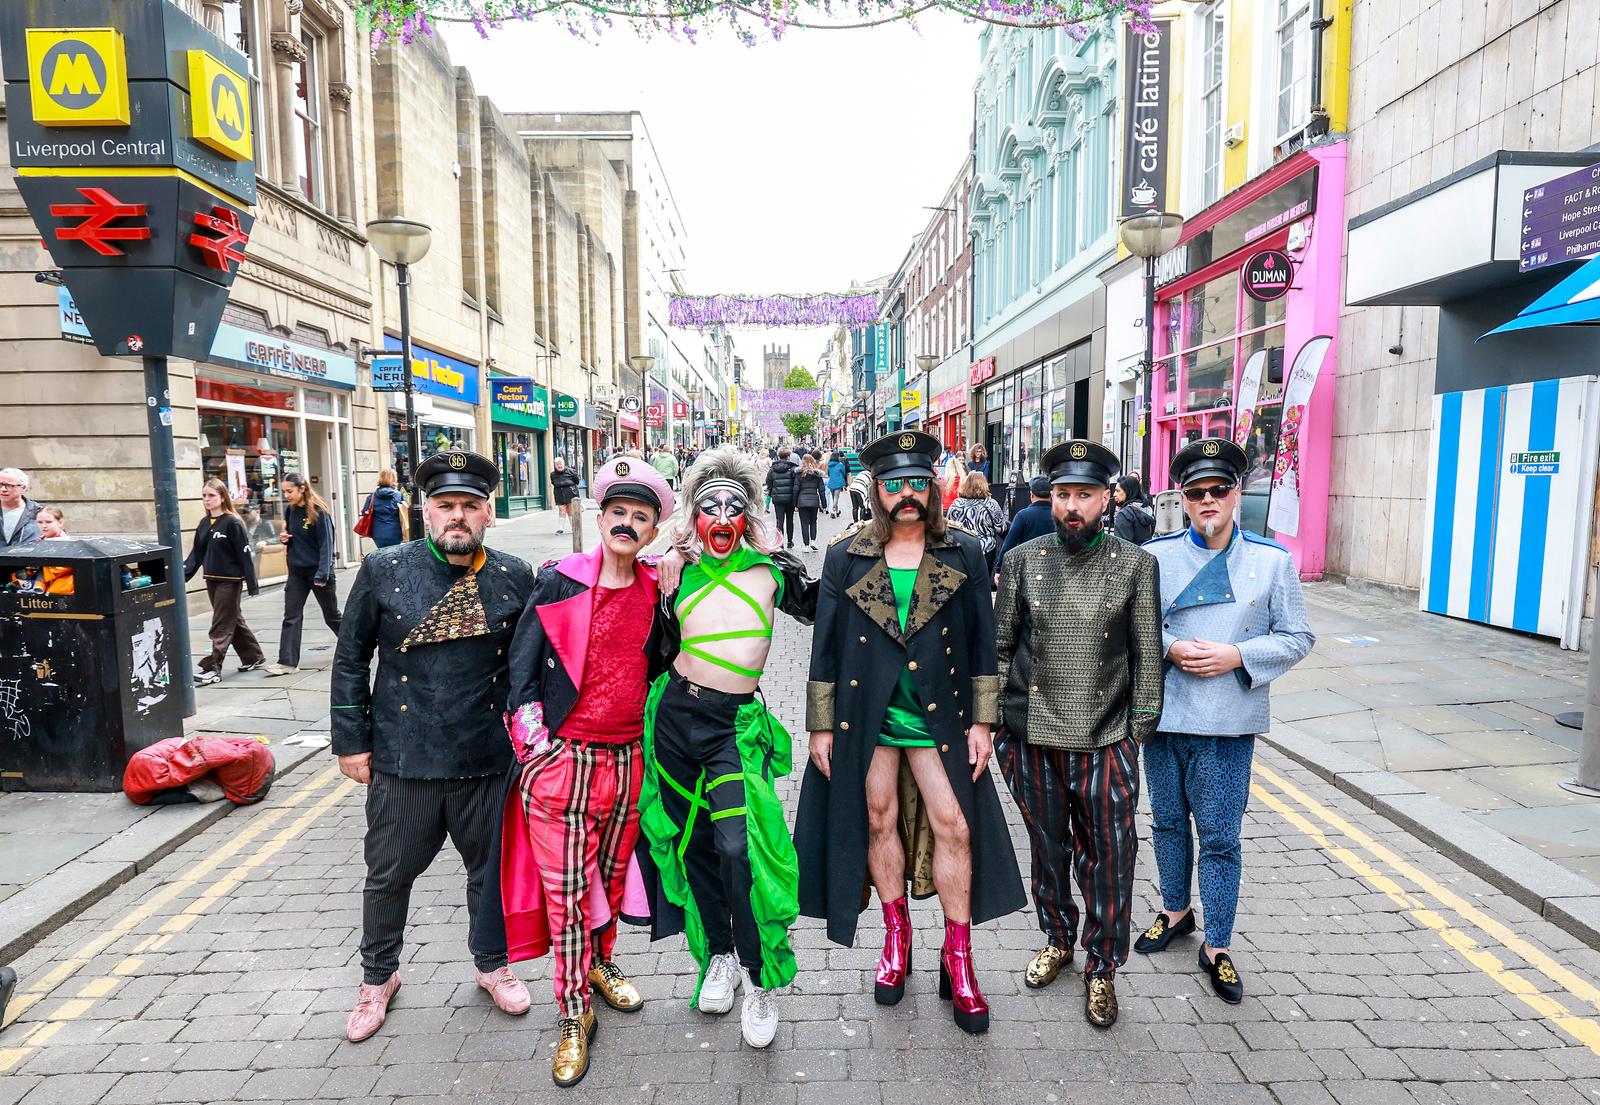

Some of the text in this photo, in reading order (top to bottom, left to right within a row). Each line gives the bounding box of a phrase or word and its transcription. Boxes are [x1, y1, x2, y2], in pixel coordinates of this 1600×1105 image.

[1135, 31, 1161, 172] café latino
[16, 139, 165, 159] Liverpool Central
[1564, 190, 1583, 205] FACT
[1585, 188, 1591, 198] &
[1562, 210, 1581, 223] Hope
[1559, 222, 1592, 240] Liverpool
[1252, 269, 1286, 283] DUMAN
[291, 351, 327, 376] NERO
[503, 385, 523, 393] Card
[497, 393, 528, 402] Factory
[1522, 453, 1555, 462] Fire exit
[1521, 464, 1555, 473] Keep clear
[20, 597, 54, 609] Litter
